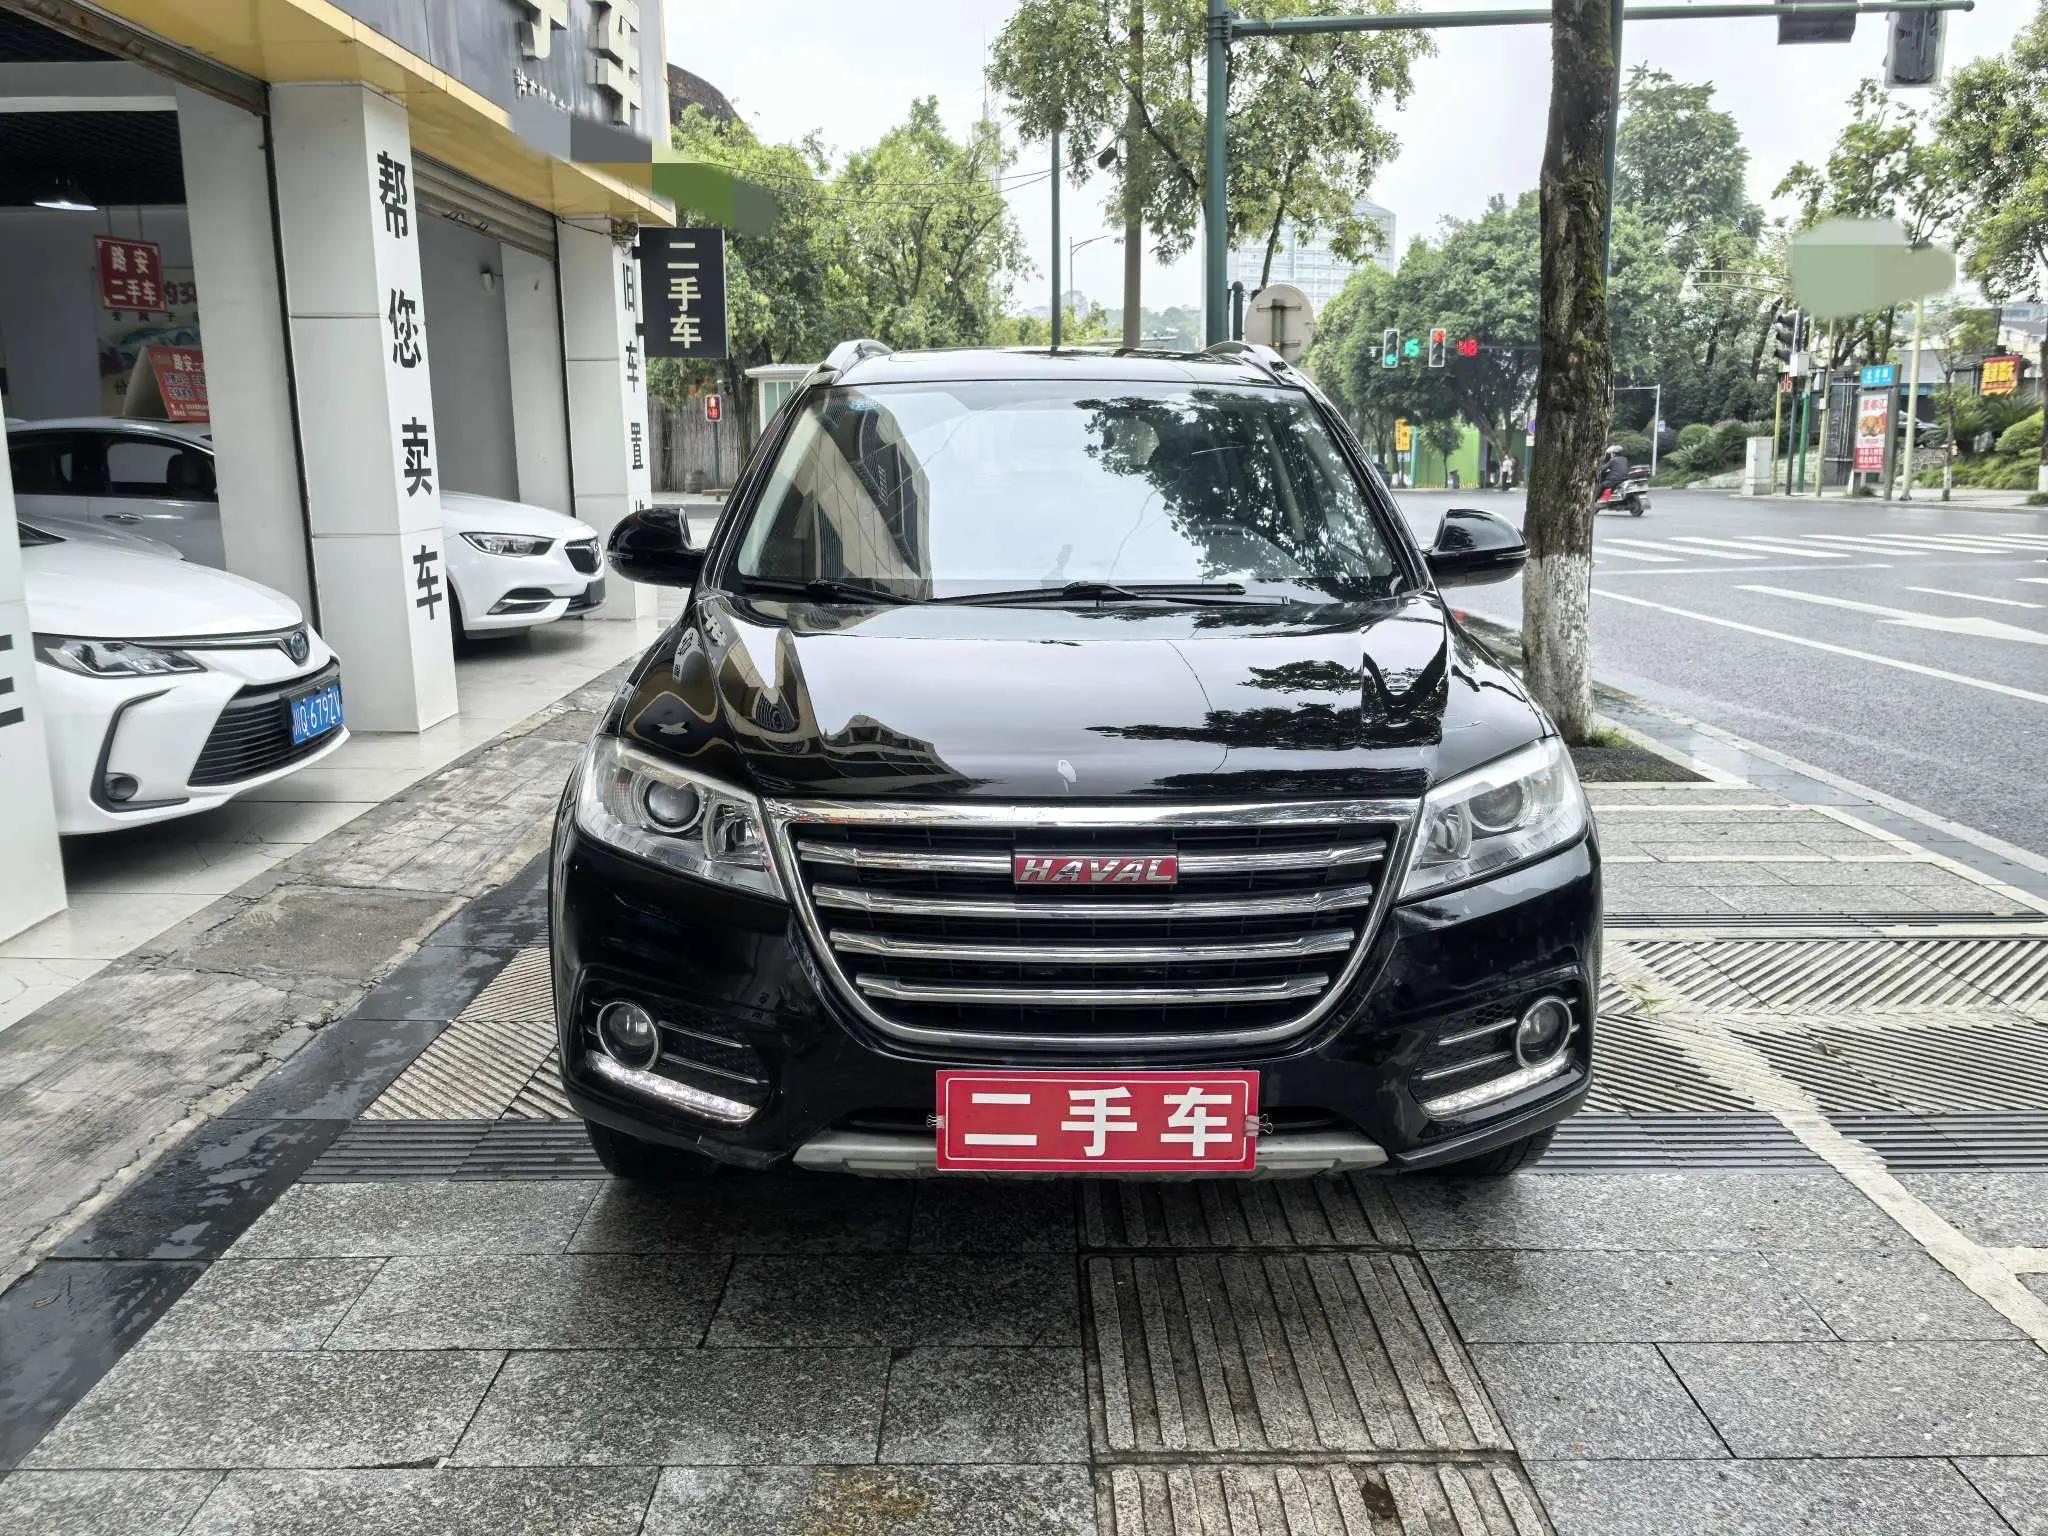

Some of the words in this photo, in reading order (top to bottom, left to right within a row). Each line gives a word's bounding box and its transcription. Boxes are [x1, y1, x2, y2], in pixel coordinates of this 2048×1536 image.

[111, 279, 157, 305] 二手车
[667, 242, 701, 349] 二手车
[376, 151, 442, 620] 帮您卖车
[622, 262, 645, 512] 旧车置
[1020, 859, 1172, 882] HAVAL
[964, 1086, 1233, 1157] 二手车
